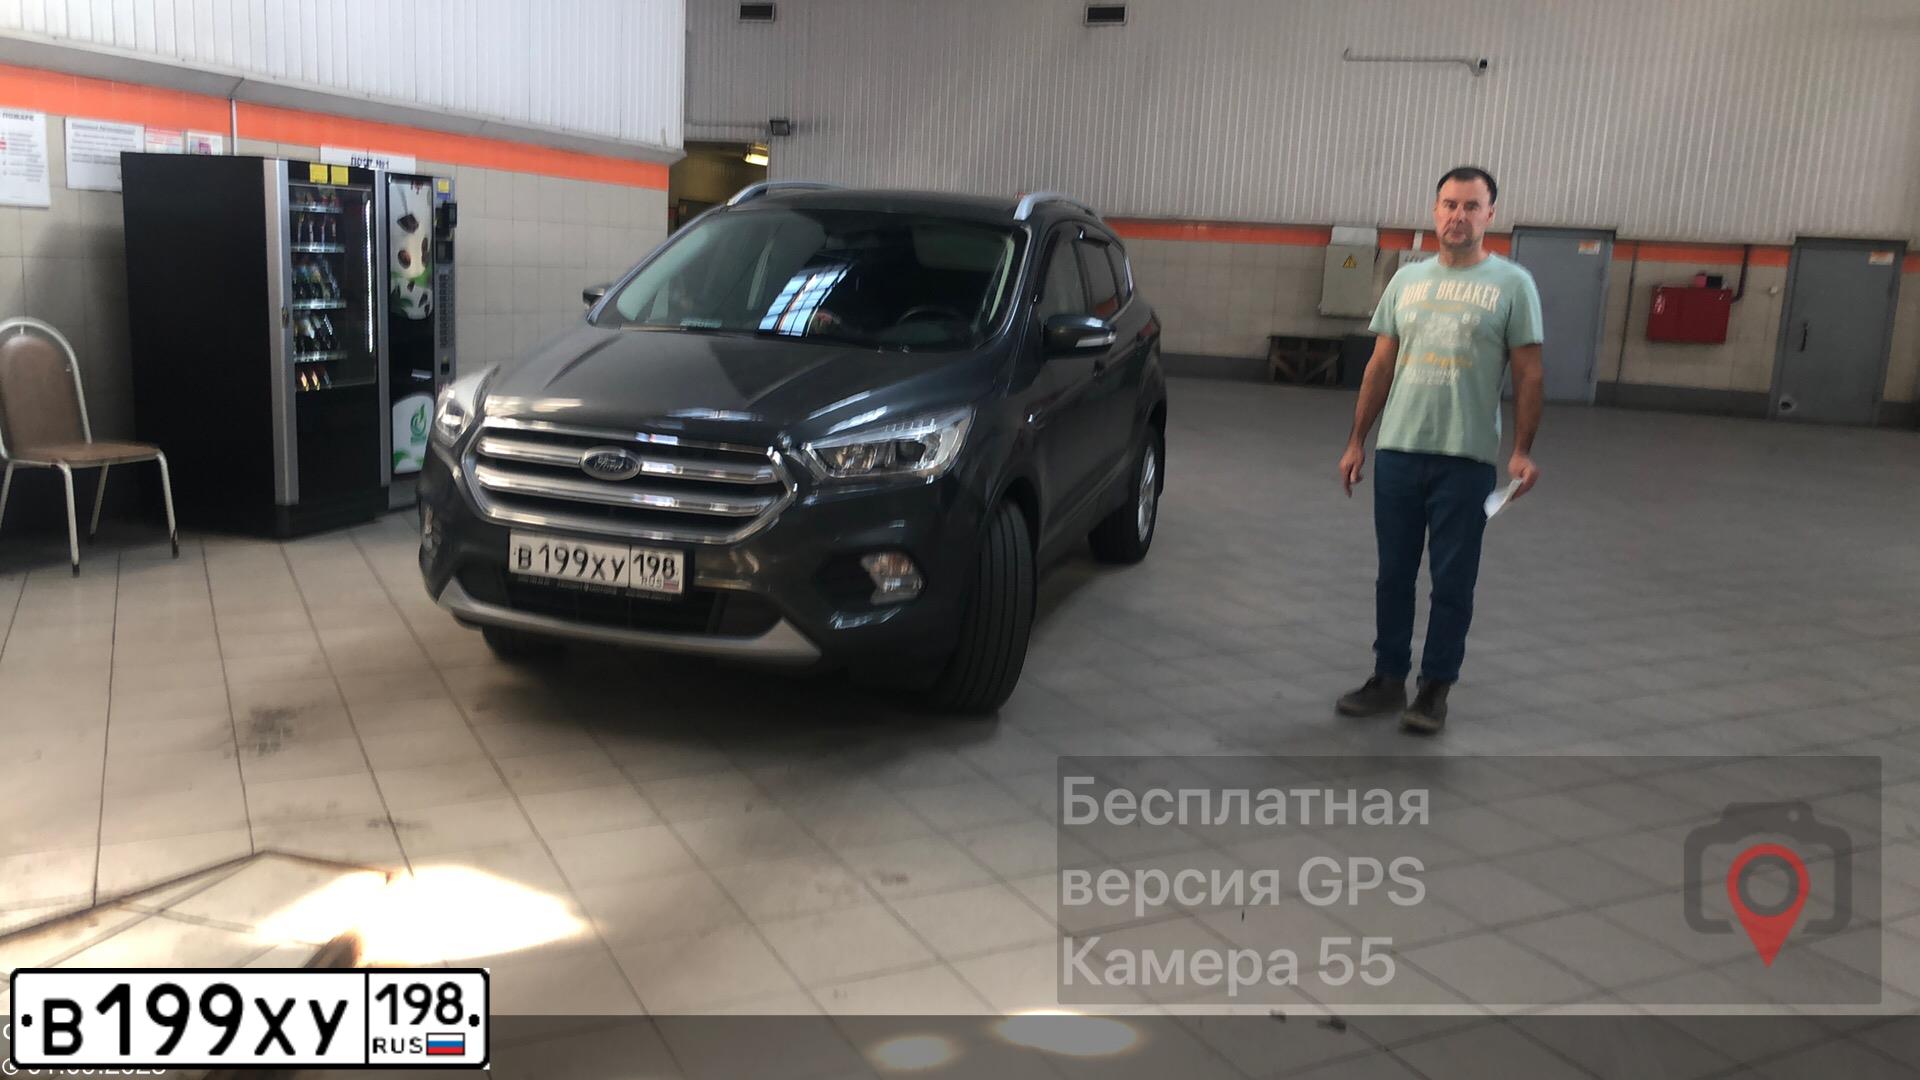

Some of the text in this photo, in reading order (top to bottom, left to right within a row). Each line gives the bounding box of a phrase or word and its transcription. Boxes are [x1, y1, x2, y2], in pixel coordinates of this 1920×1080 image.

[1436, 280, 1500, 314] BREAKER
[593, 457, 625, 473] Ford
[633, 552, 676, 580] 198
